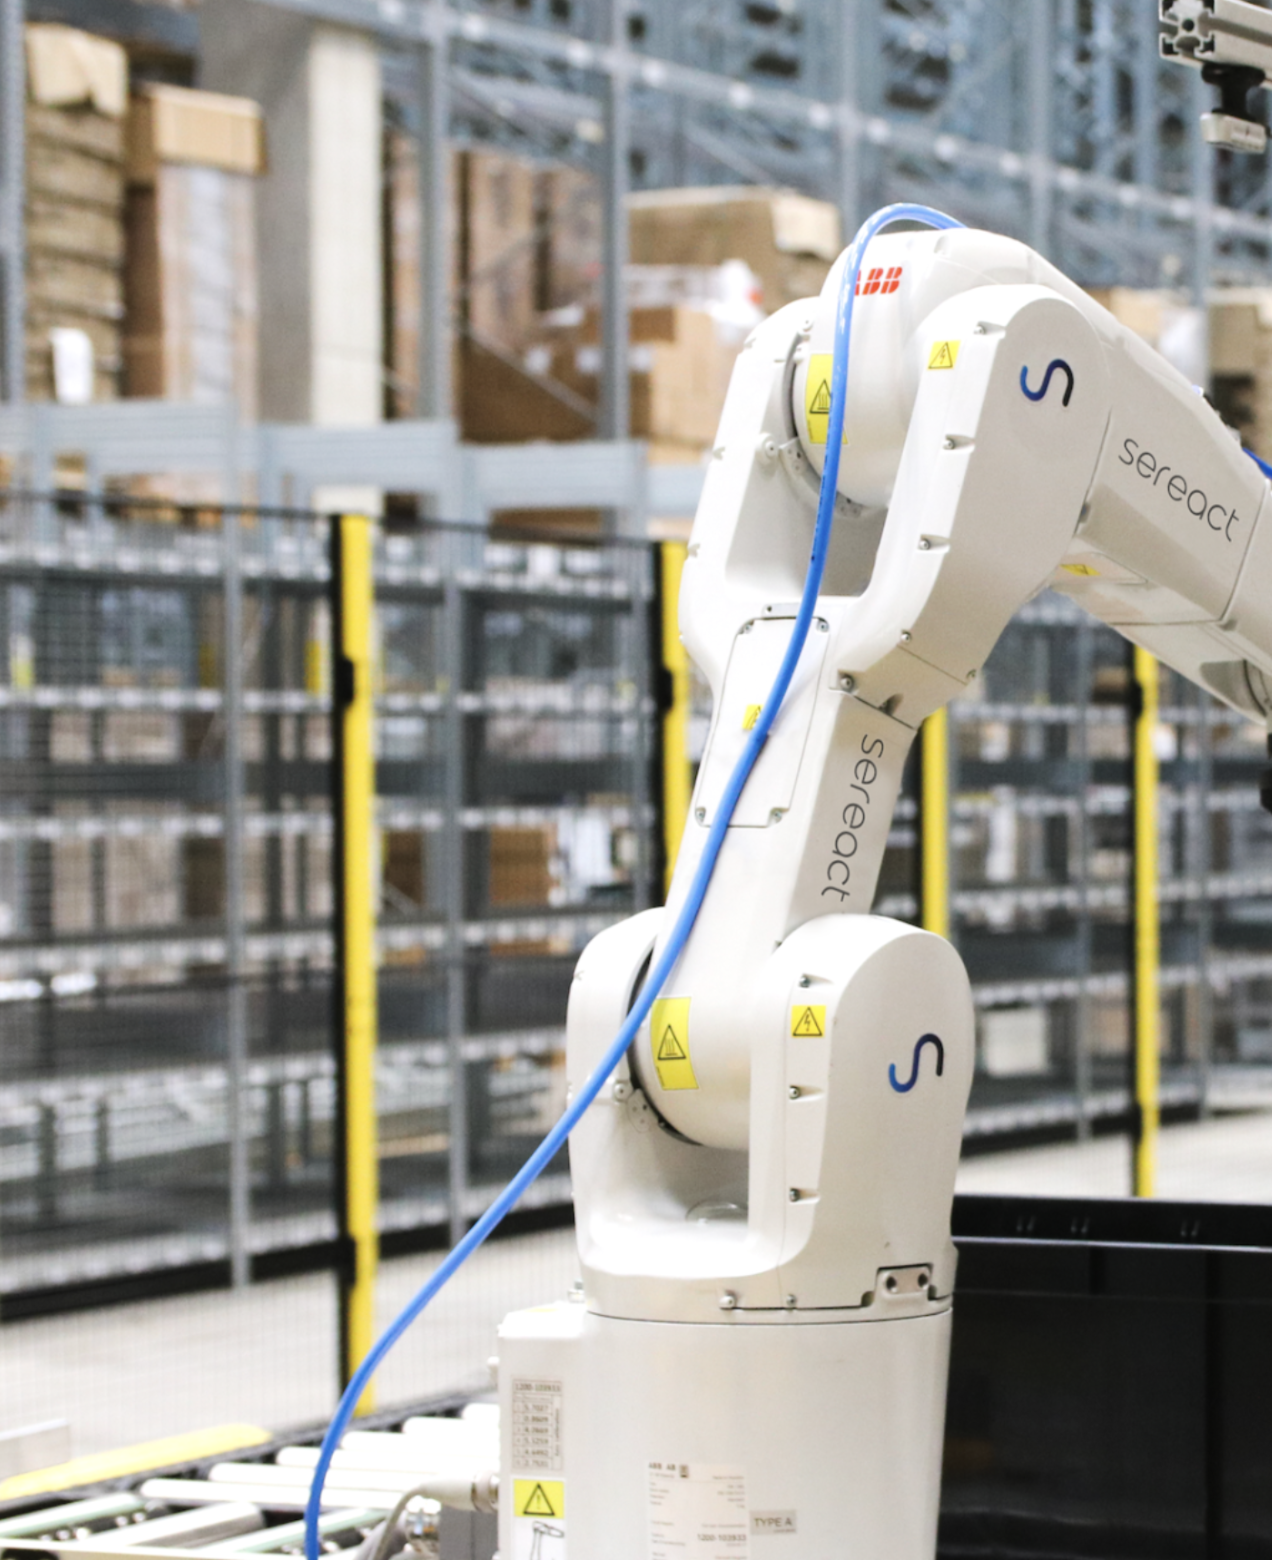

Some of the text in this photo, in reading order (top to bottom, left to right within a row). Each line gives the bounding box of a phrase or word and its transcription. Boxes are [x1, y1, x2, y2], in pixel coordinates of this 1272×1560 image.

[1118, 438, 1240, 543] sereact
[821, 734, 884, 902] sereact
[754, 1517, 782, 1527] TYPE
[785, 1517, 793, 1526] A
